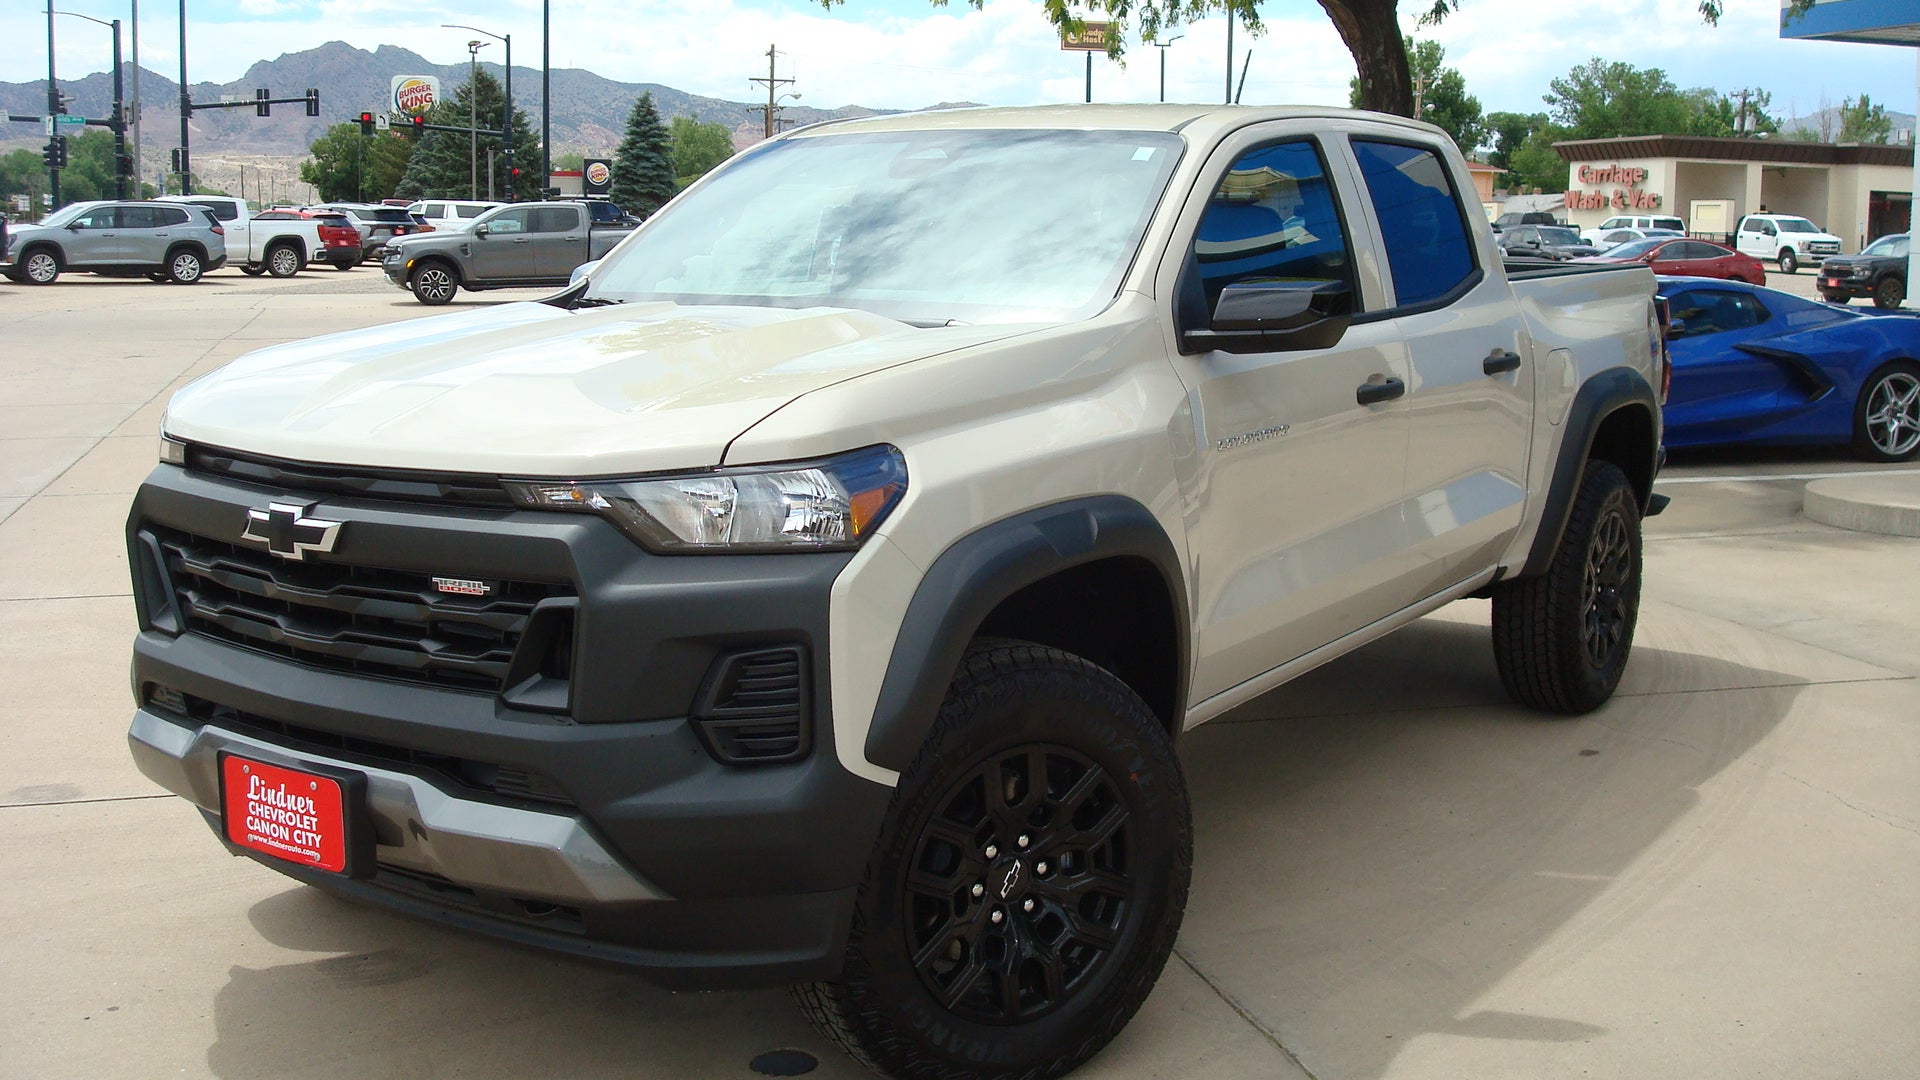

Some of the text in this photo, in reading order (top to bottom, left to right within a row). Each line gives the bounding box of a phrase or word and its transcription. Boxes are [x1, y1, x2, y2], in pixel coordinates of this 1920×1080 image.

[399, 84, 431, 99] BURGER
[401, 93, 433, 110] KING
[1578, 164, 1644, 187] Carriage
[1564, 188, 1658, 209] Wash & Vac
[247, 774, 316, 815] Lindner
[248, 801, 318, 831] CHEVROLET
[246, 816, 322, 848] CANON CITY
